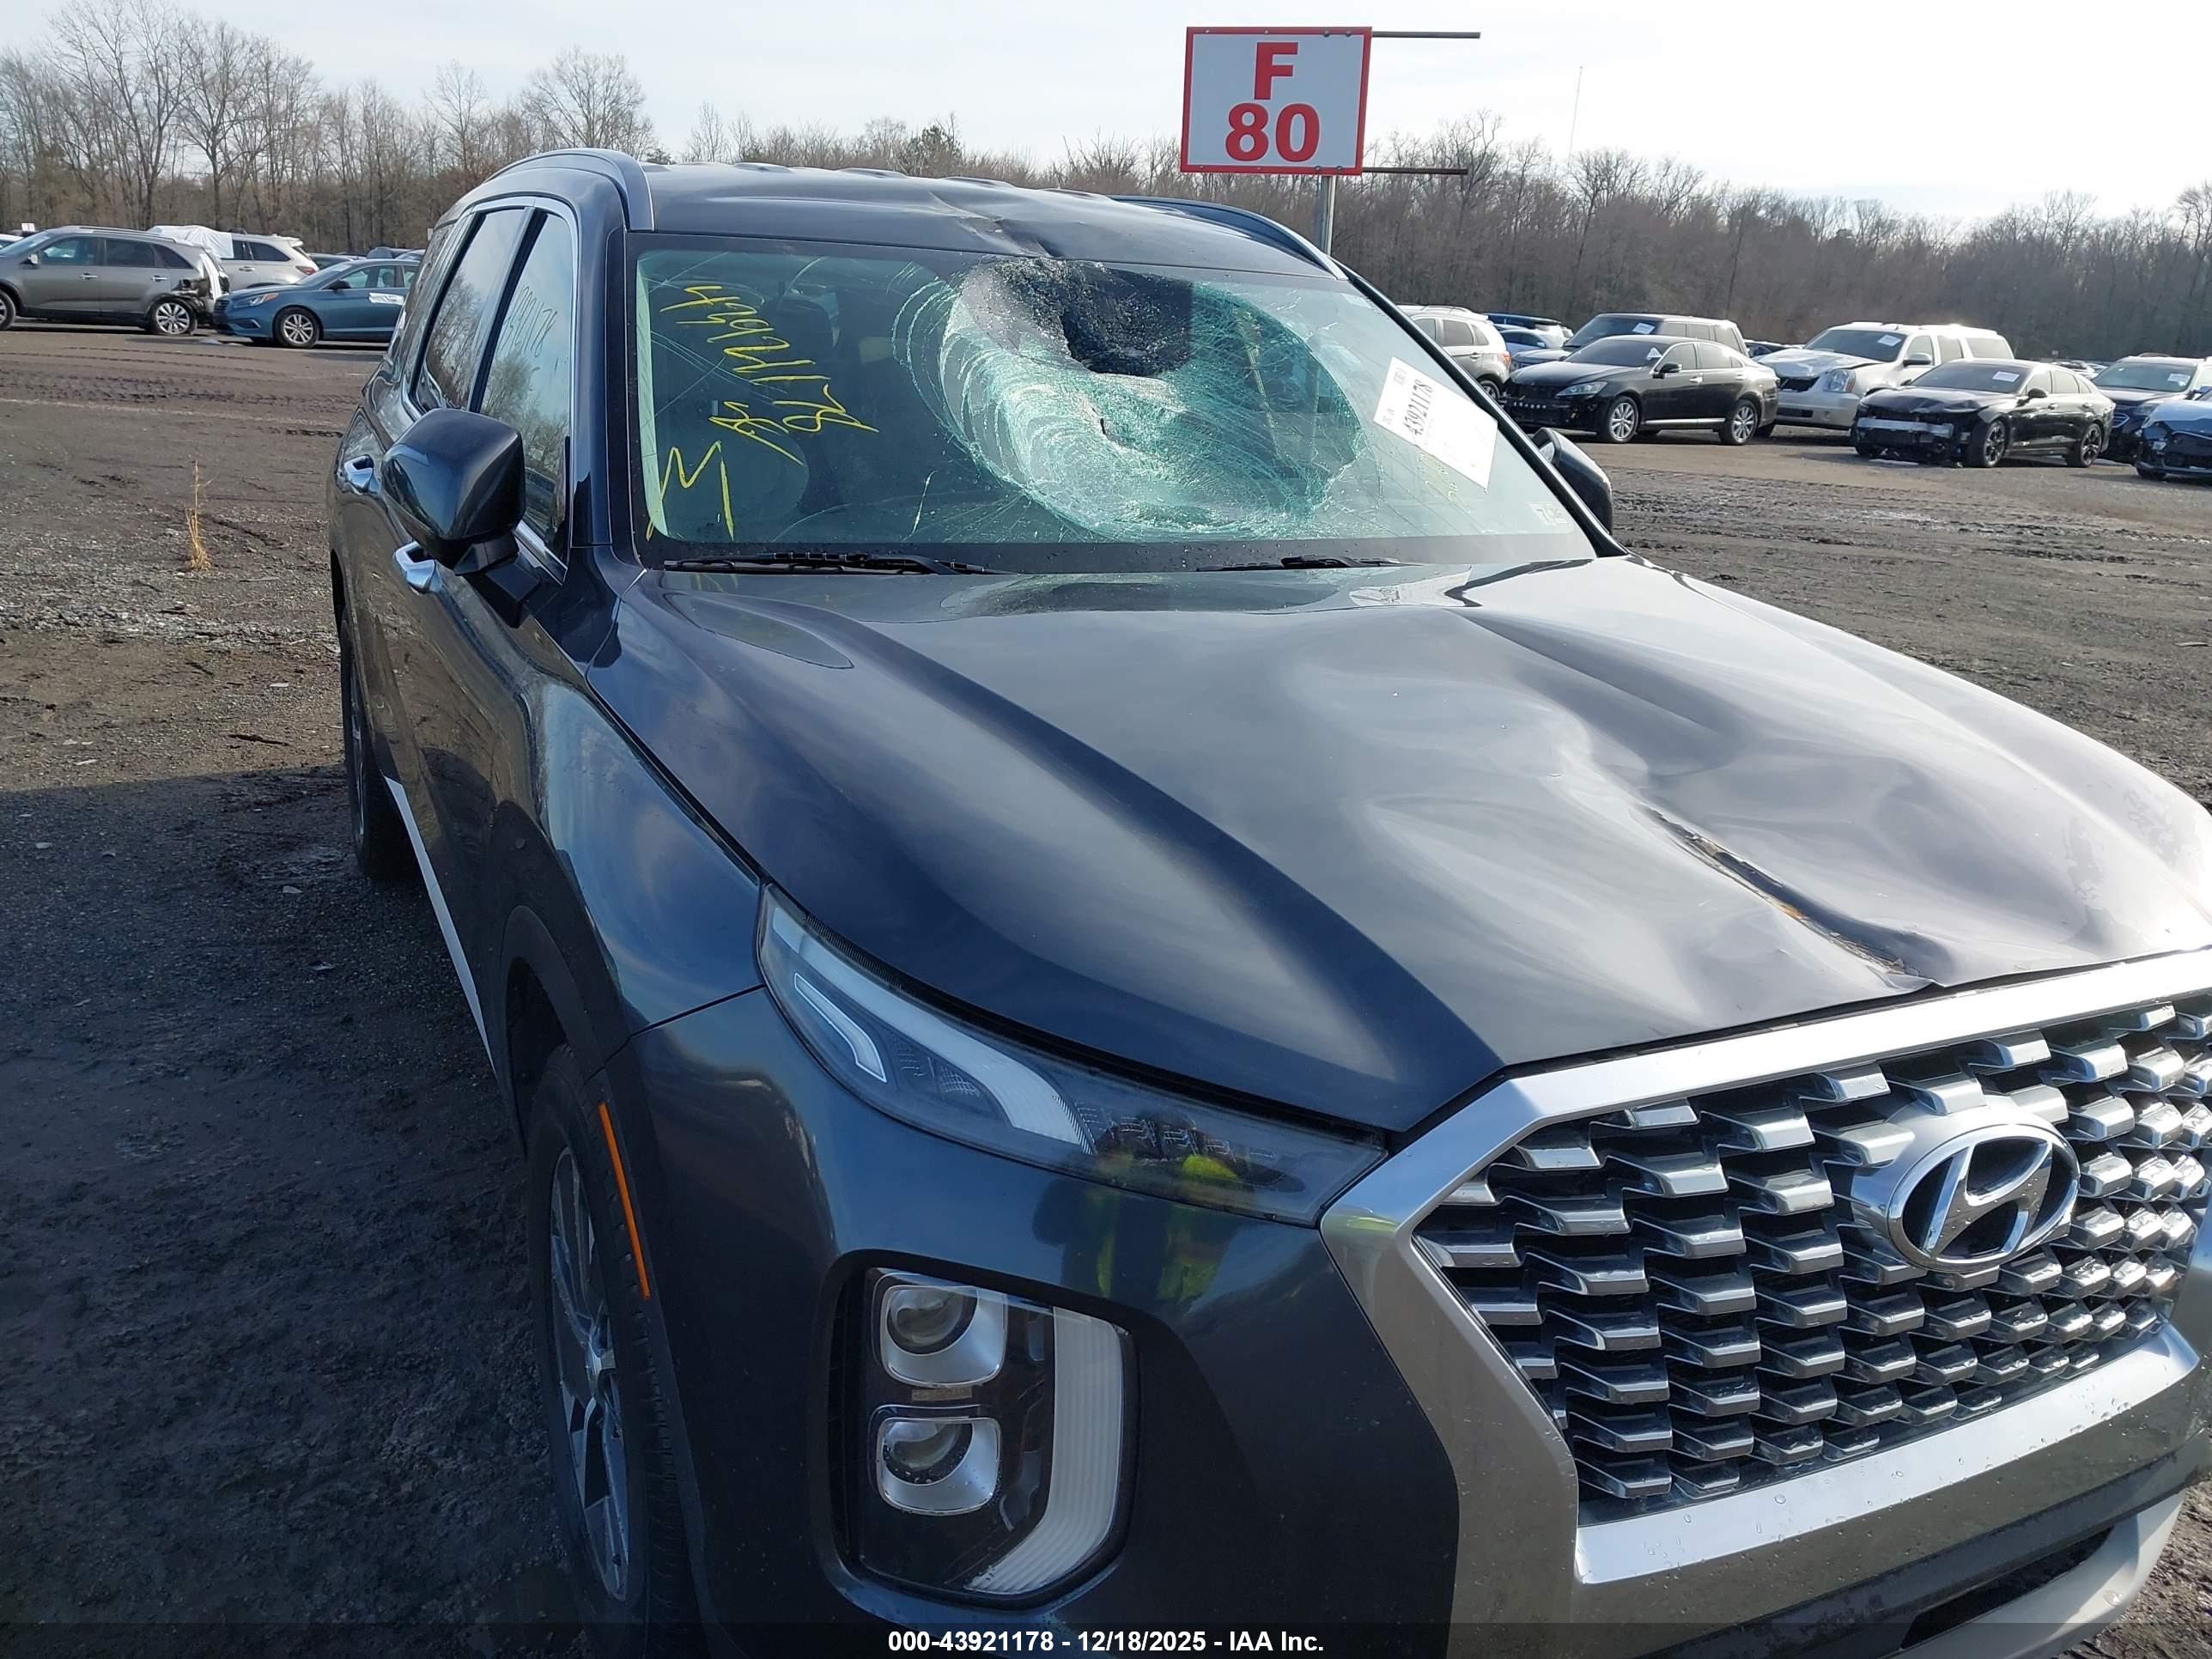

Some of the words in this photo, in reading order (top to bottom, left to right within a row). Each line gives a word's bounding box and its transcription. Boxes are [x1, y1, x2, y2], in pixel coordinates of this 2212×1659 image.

[1253, 41, 1299, 100] F
[1224, 102, 1321, 162] 80
[659, 285, 880, 433] 43921178
[1402, 378, 1434, 436] 43921178
